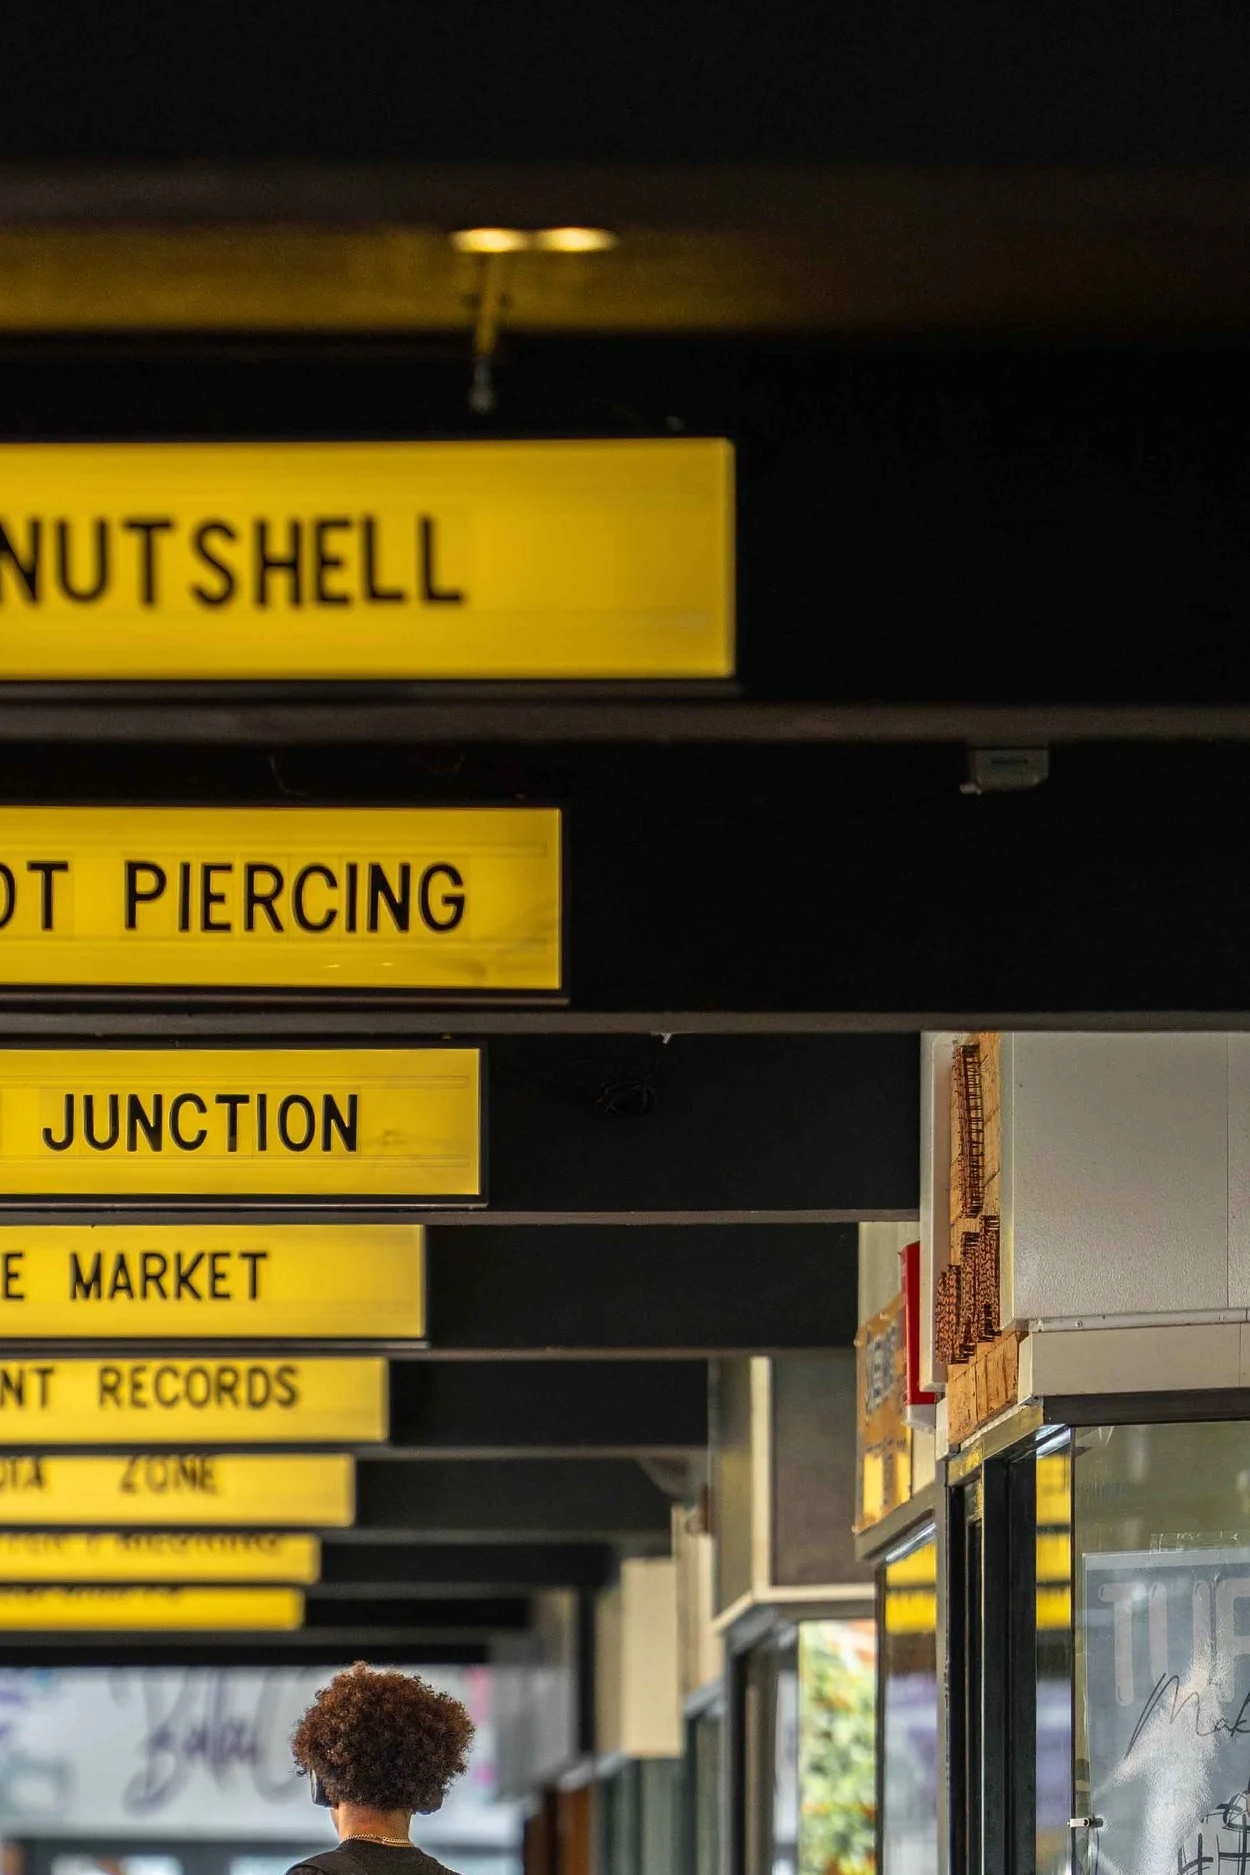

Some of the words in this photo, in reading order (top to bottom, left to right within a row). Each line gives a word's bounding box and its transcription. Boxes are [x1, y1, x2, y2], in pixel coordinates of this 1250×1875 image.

[125, 861, 466, 933] PIERCING
[42, 1093, 358, 1152] JUNCTION
[70, 1251, 269, 1300] MARKET
[99, 1366, 299, 1409] RECORDS
[120, 1455, 216, 1491] ZONE
